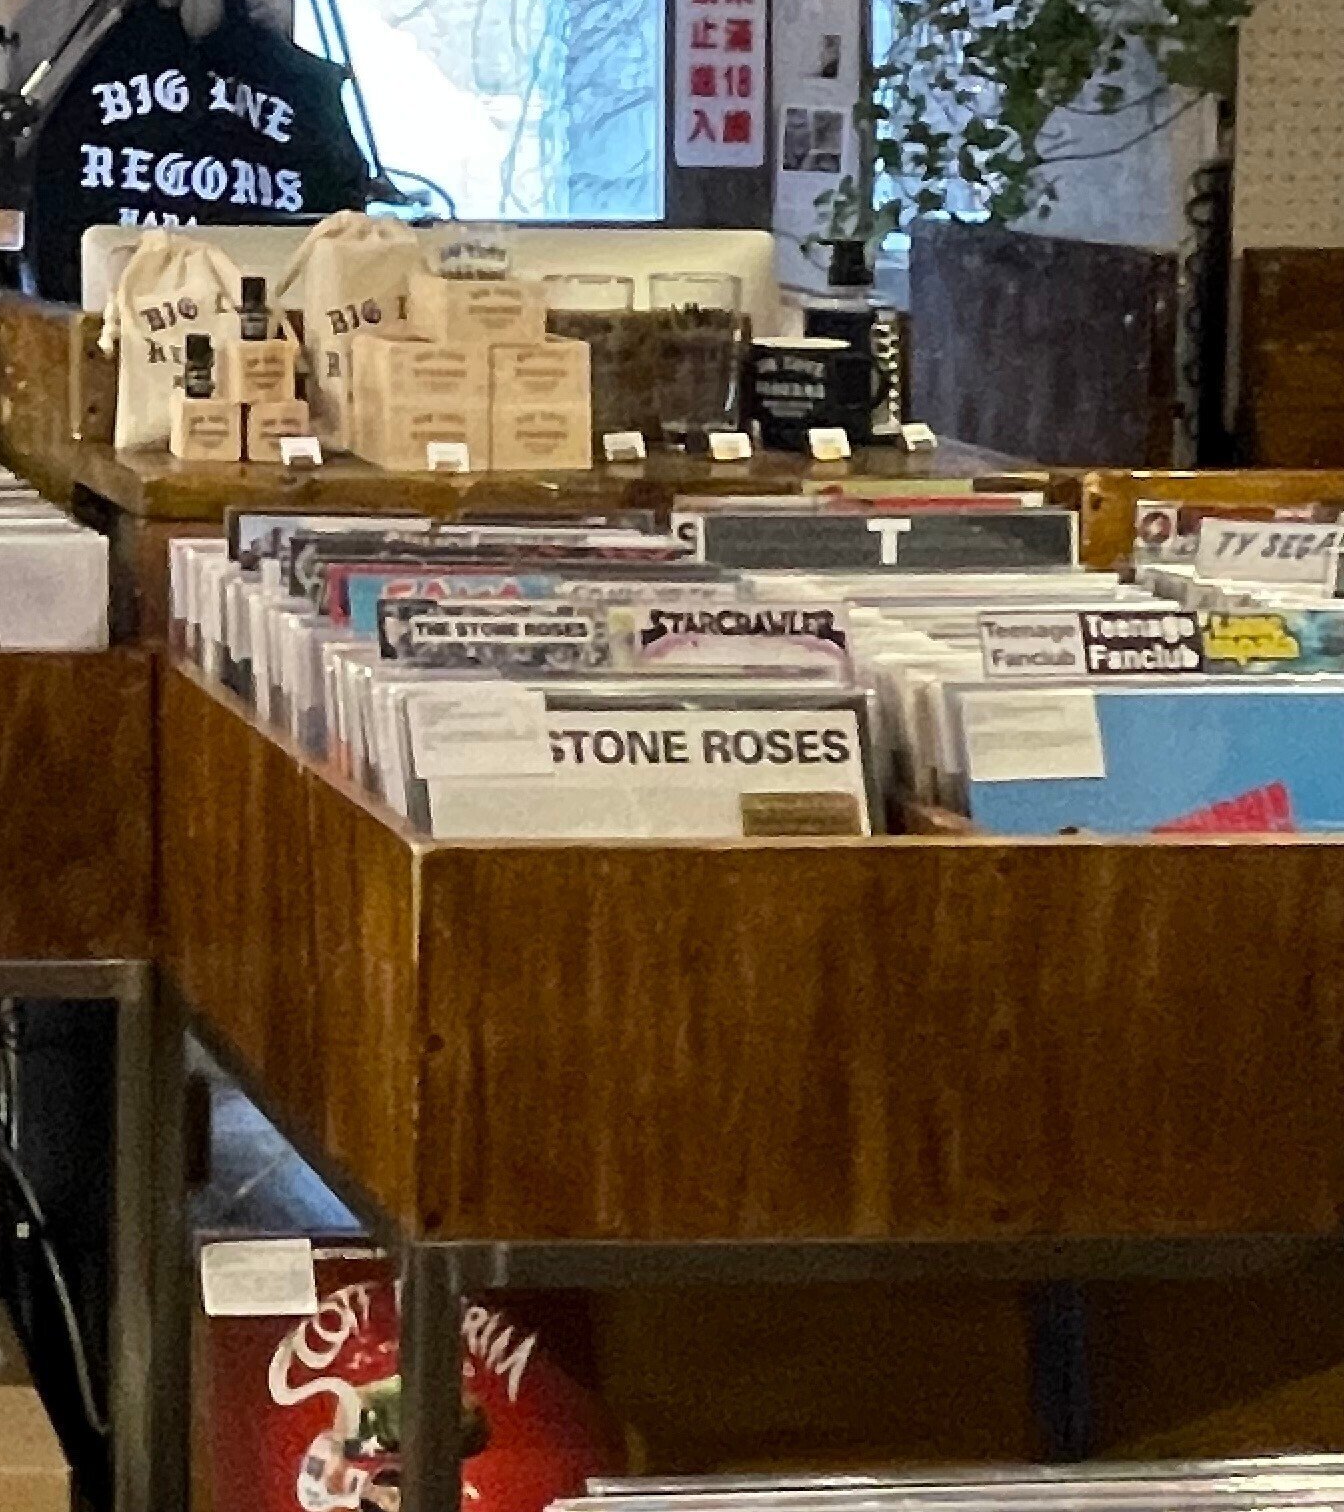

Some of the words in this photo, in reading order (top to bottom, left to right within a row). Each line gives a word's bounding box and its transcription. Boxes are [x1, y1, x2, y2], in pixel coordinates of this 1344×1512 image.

[90, 68, 190, 126] BIG
[866, 518, 912, 565] T
[1216, 531, 1259, 558] TY
[1259, 532, 1344, 560] SEGA
[414, 622, 452, 637] THE
[455, 622, 520, 637] STONE
[524, 622, 589, 638] ROSES
[641, 608, 846, 650] STARCRAWLER
[980, 622, 1076, 644] Teenage
[1084, 615, 1195, 645] Teenage
[992, 649, 1076, 667] Fanclub
[1089, 644, 1200, 670] Fanclub
[702, 729, 850, 764] ROSES
